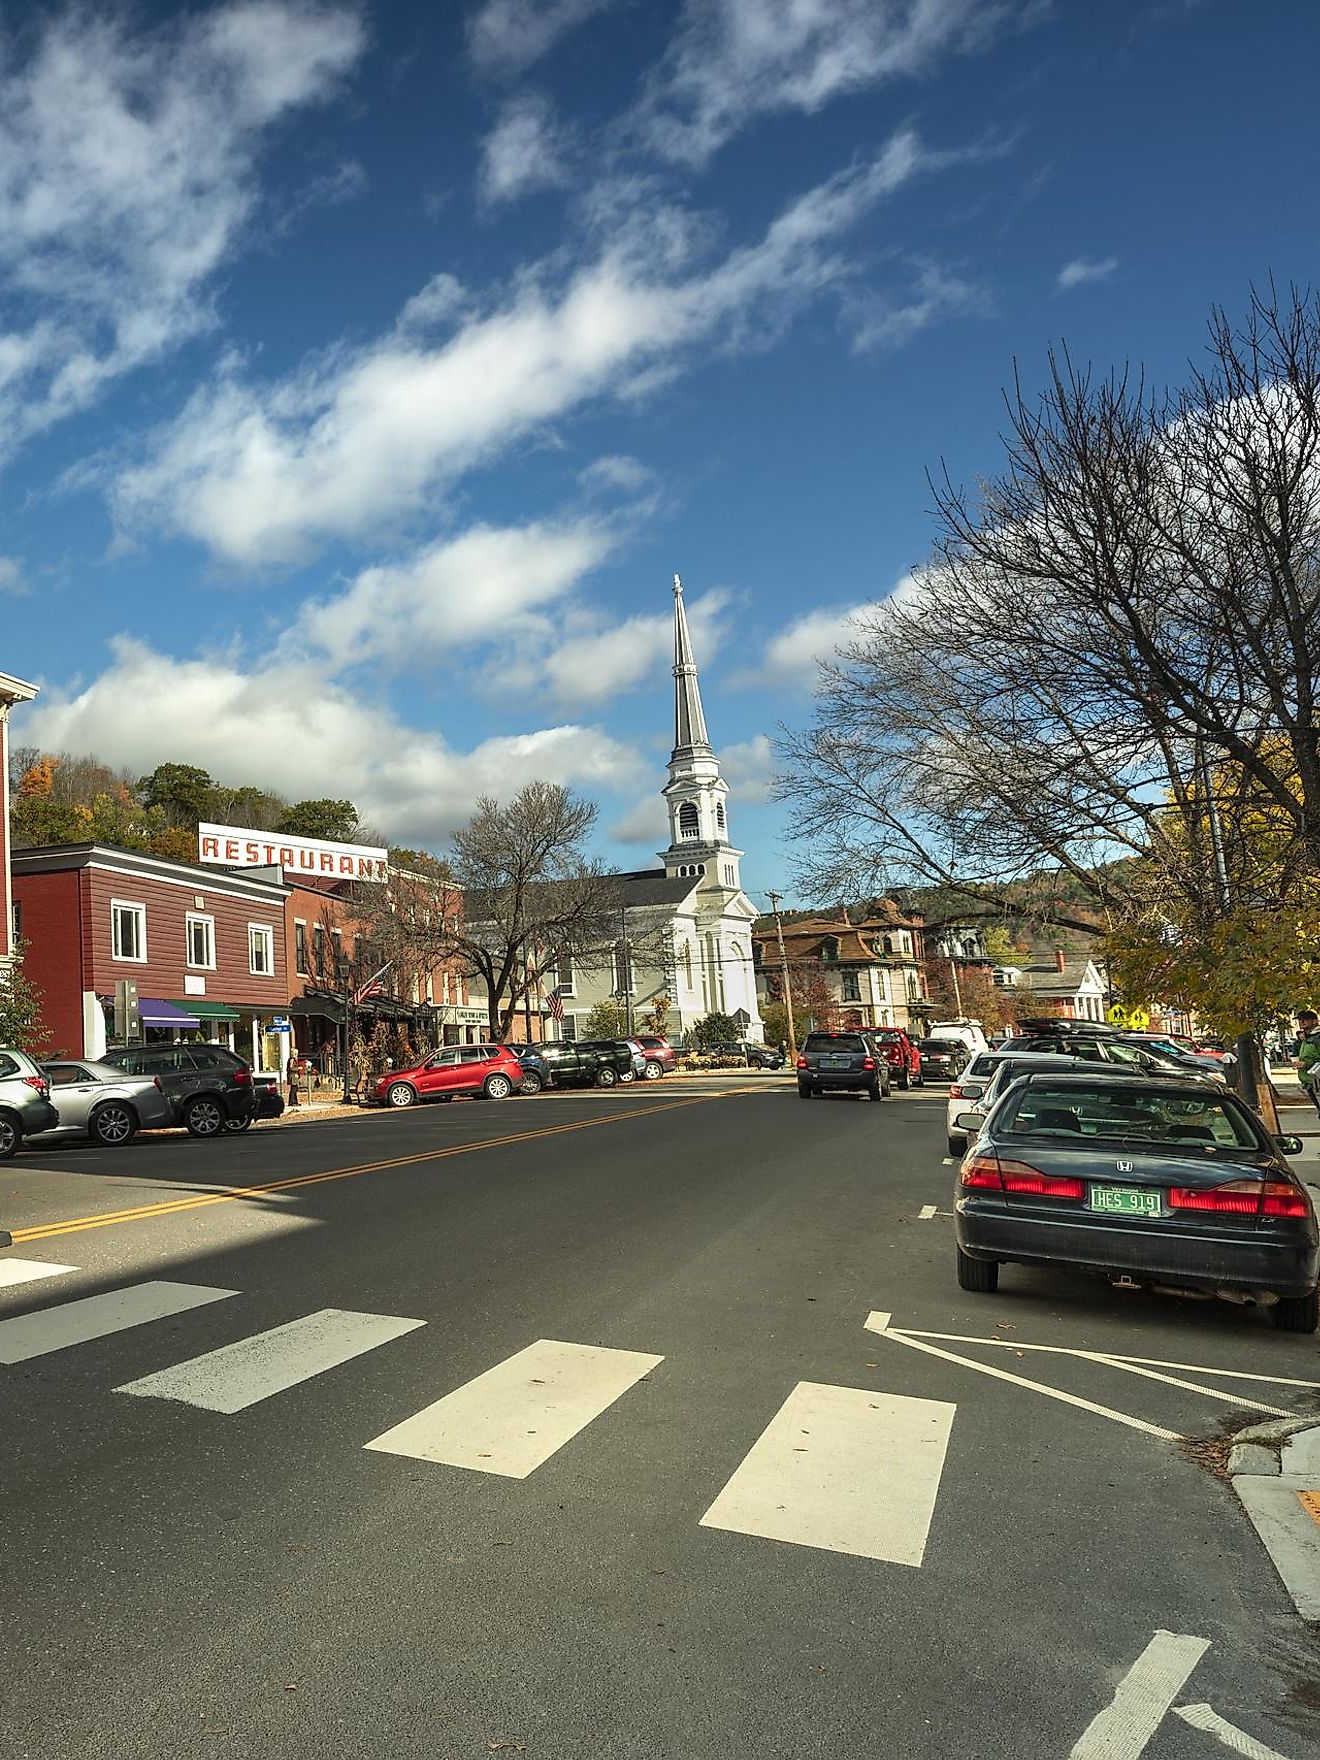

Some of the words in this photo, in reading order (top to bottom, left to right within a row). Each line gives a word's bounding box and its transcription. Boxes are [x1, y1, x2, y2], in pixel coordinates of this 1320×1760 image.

[202, 837, 387, 876] RESTAURANT
[1097, 1192, 1122, 1207] HES
[1130, 1195, 1155, 1210] 919
